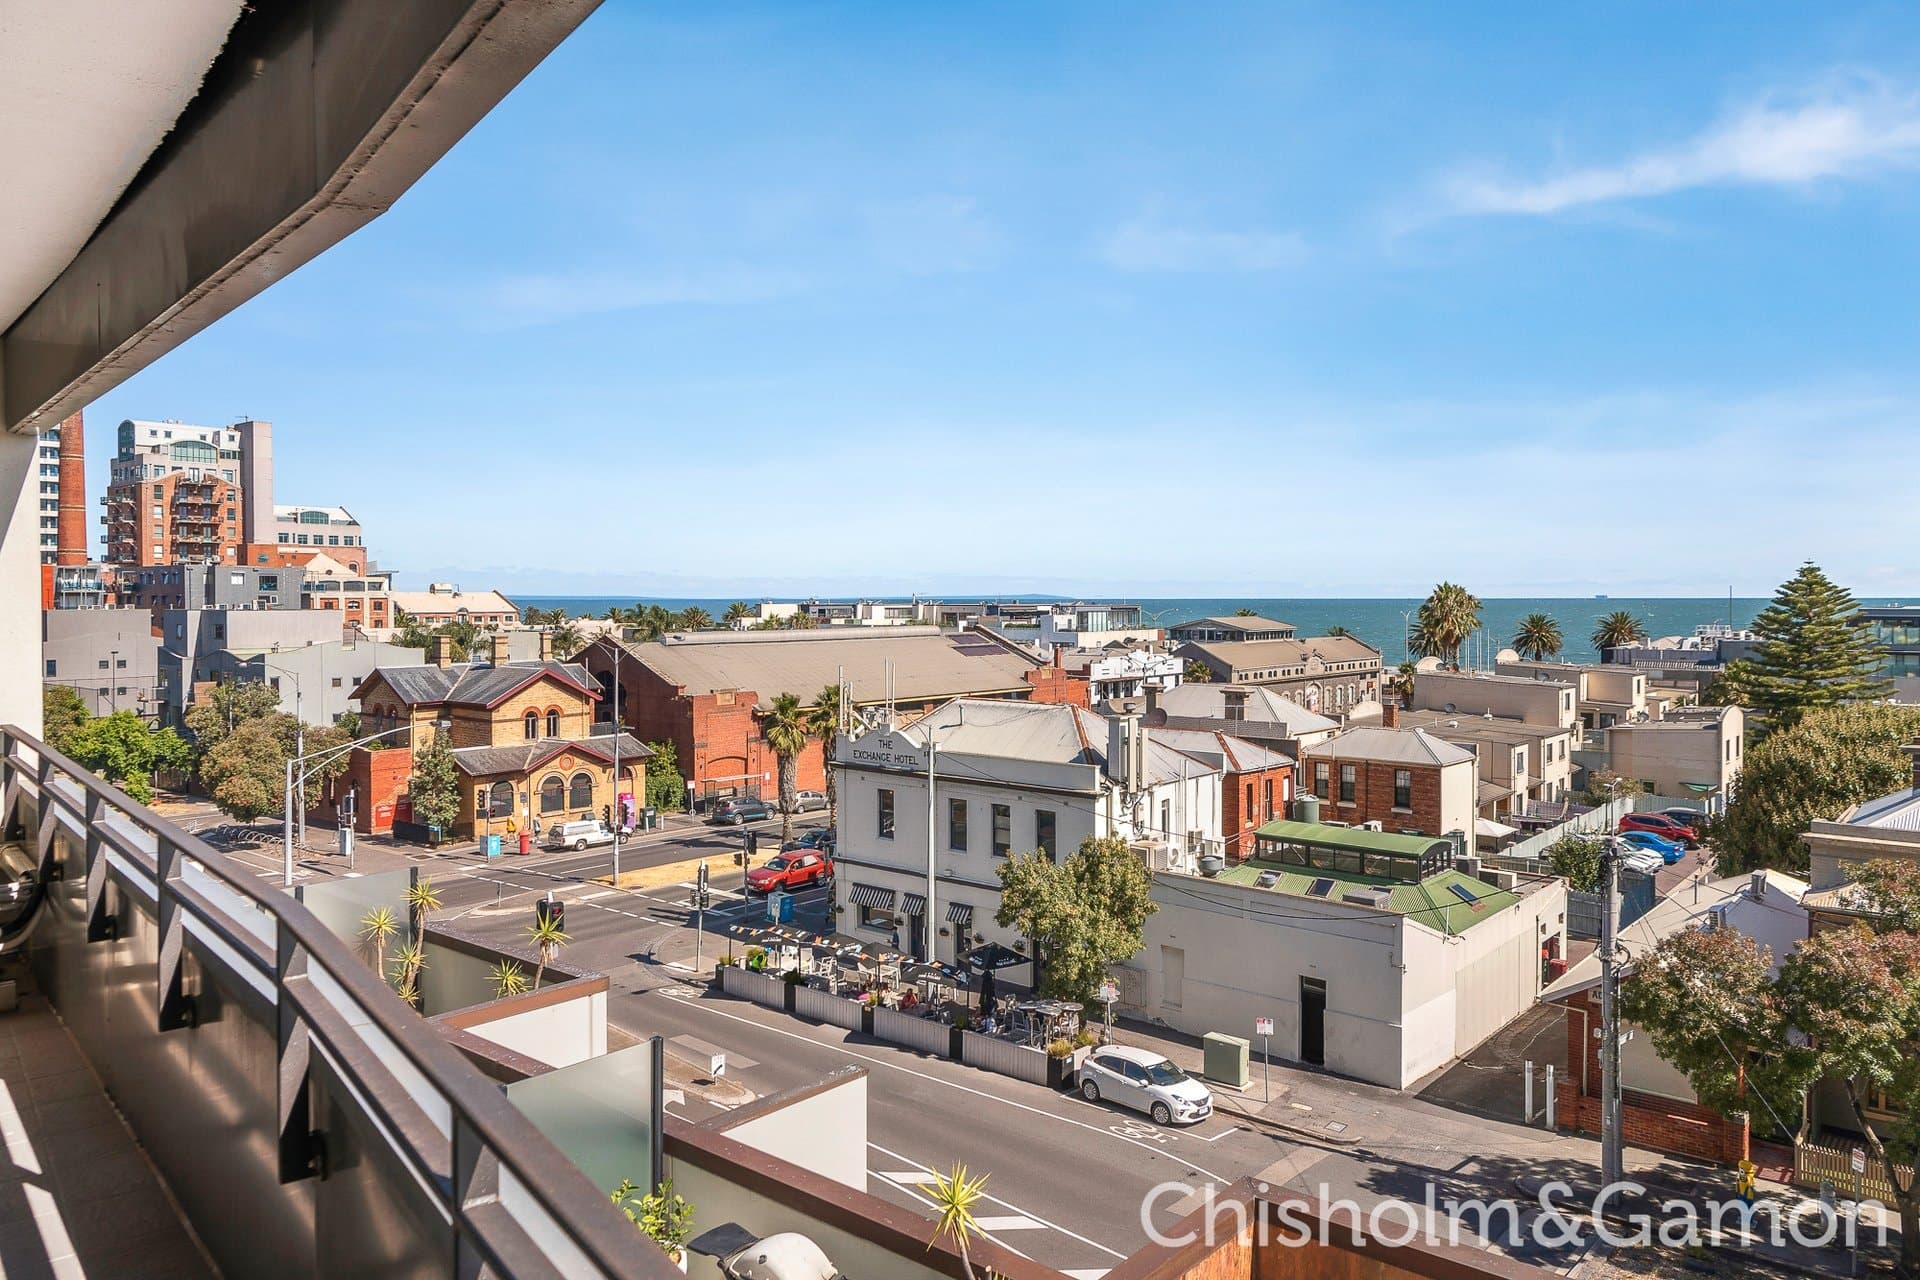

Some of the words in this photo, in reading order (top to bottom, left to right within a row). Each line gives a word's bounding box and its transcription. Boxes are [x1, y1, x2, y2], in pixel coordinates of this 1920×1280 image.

[878, 739, 893, 749] THE
[853, 749, 892, 762] EXCHANGE
[894, 754, 919, 765] HOTEL
